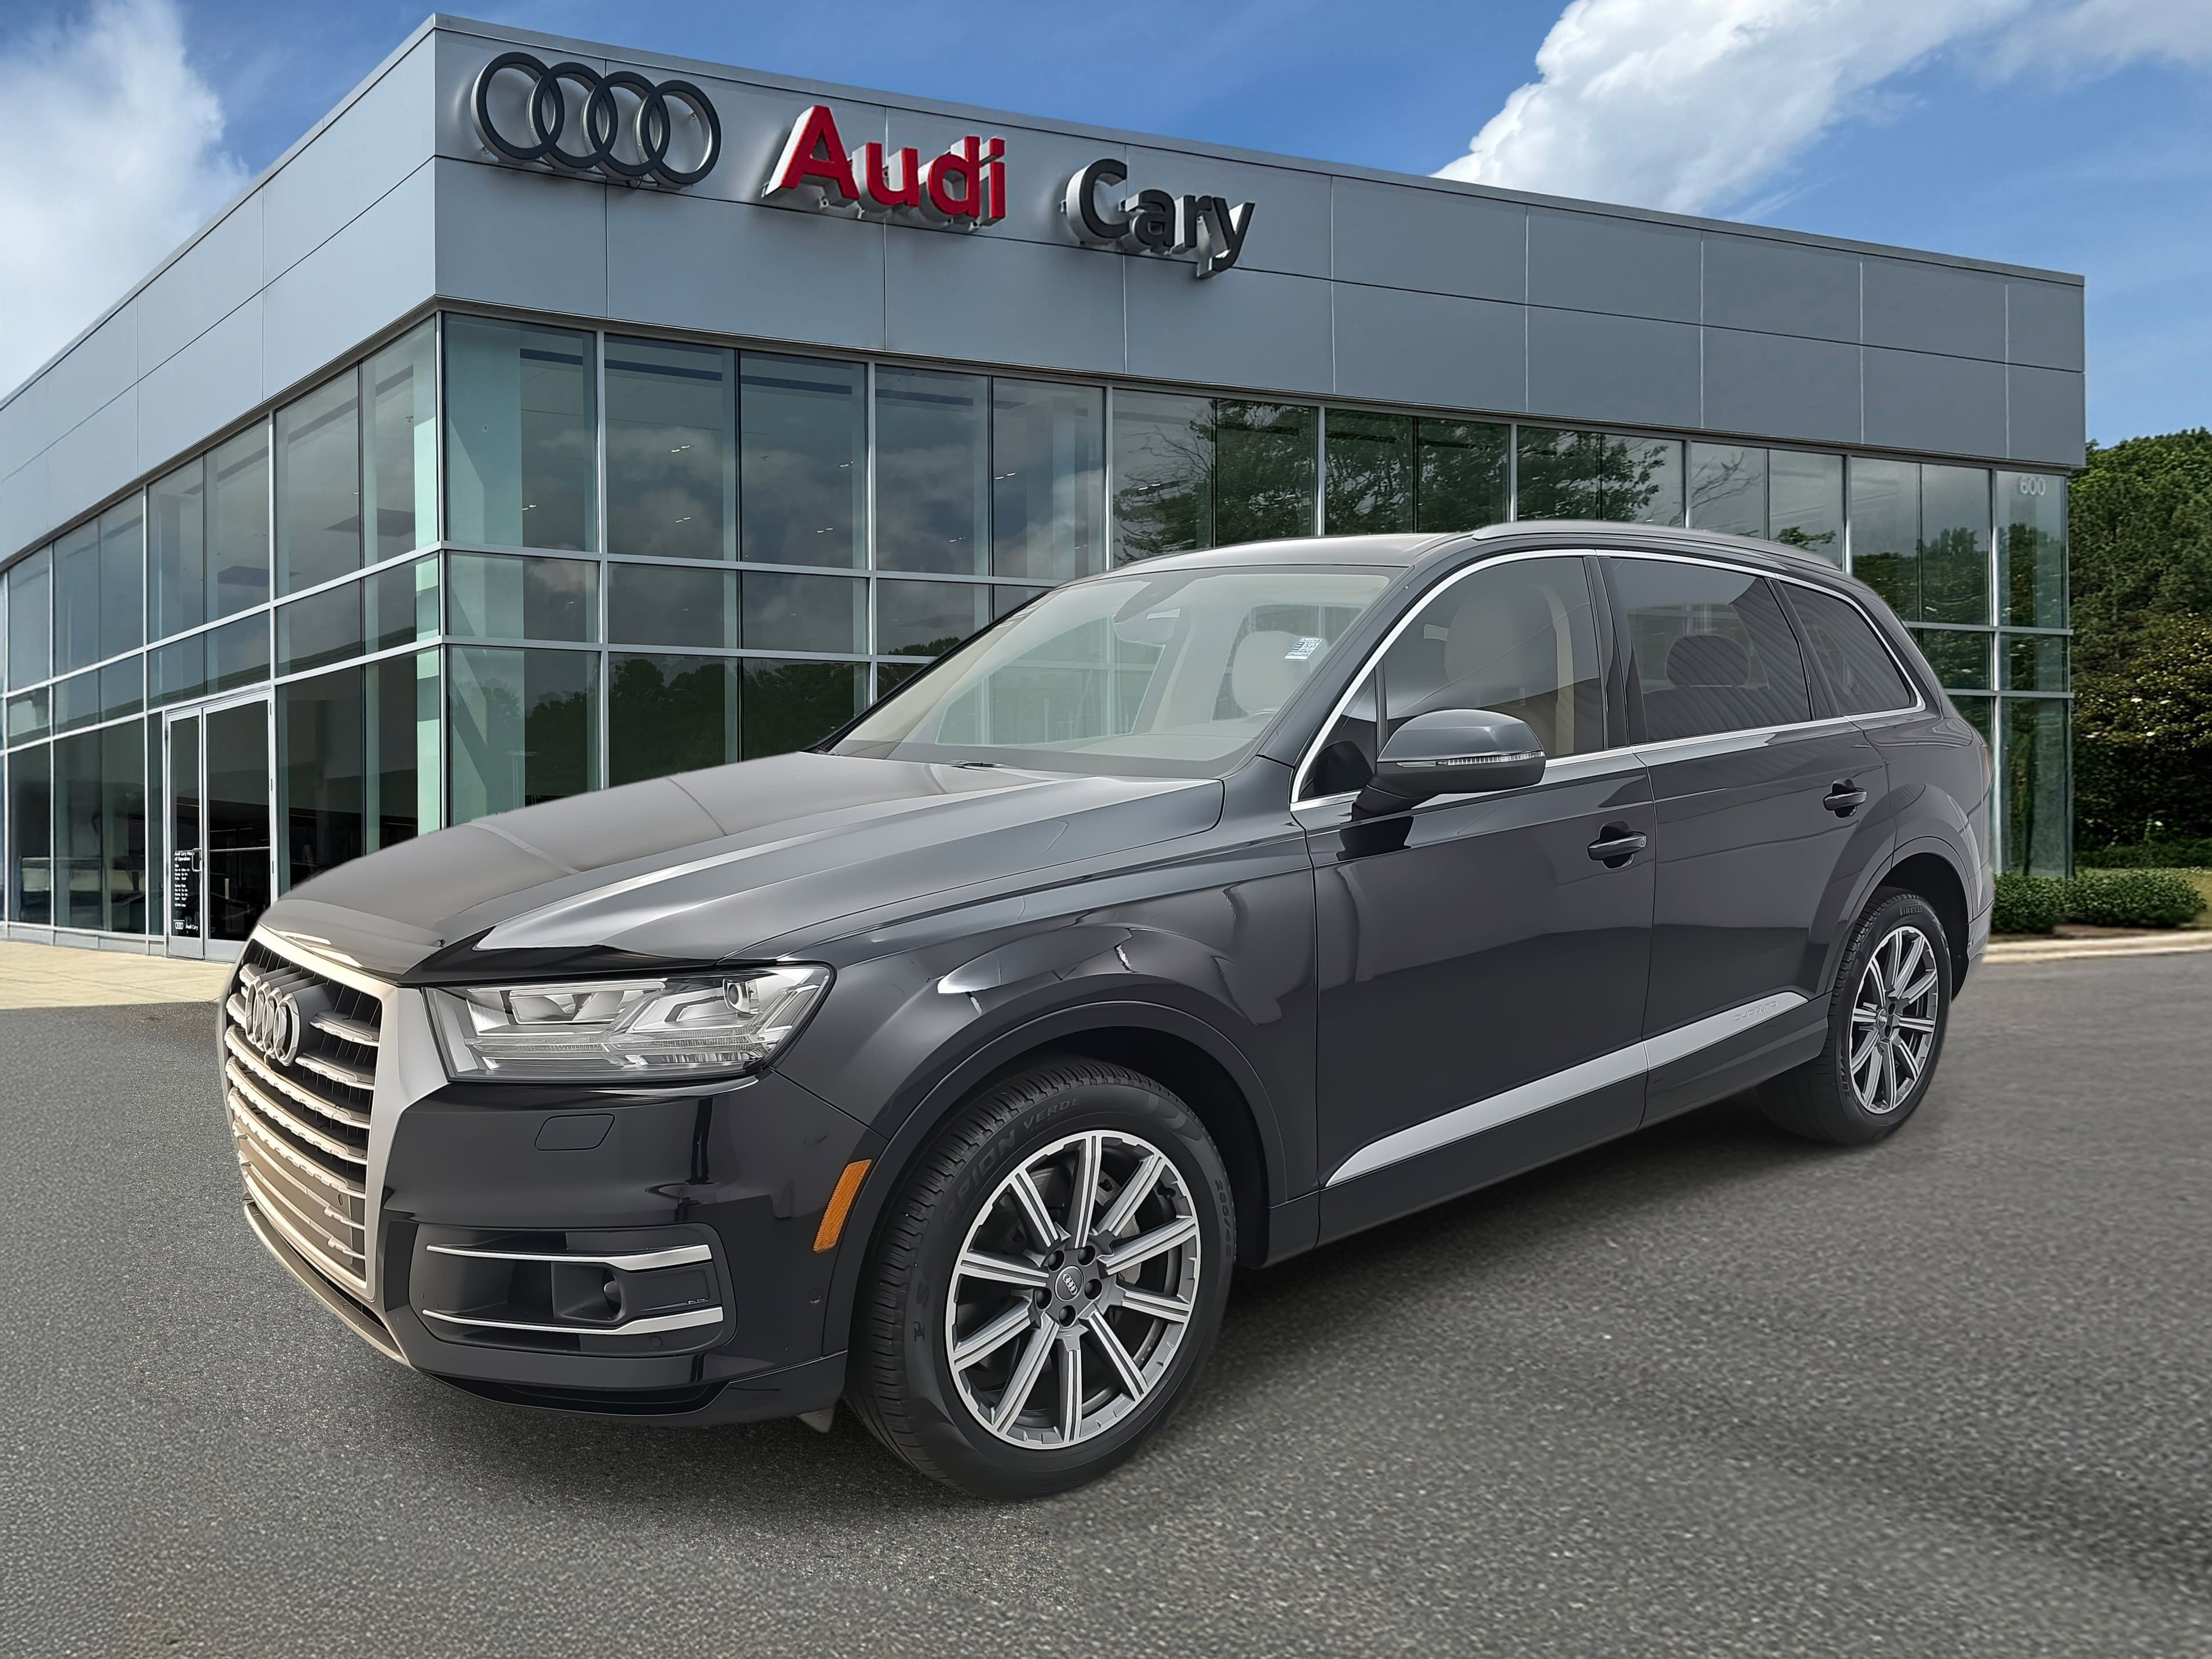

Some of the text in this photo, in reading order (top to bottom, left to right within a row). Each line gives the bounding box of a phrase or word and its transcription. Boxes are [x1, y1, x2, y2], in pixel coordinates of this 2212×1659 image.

[777, 104, 1256, 275] Audi Cary
[2020, 476, 2046, 496] 600
[1022, 1096, 1081, 1130] VERDE
